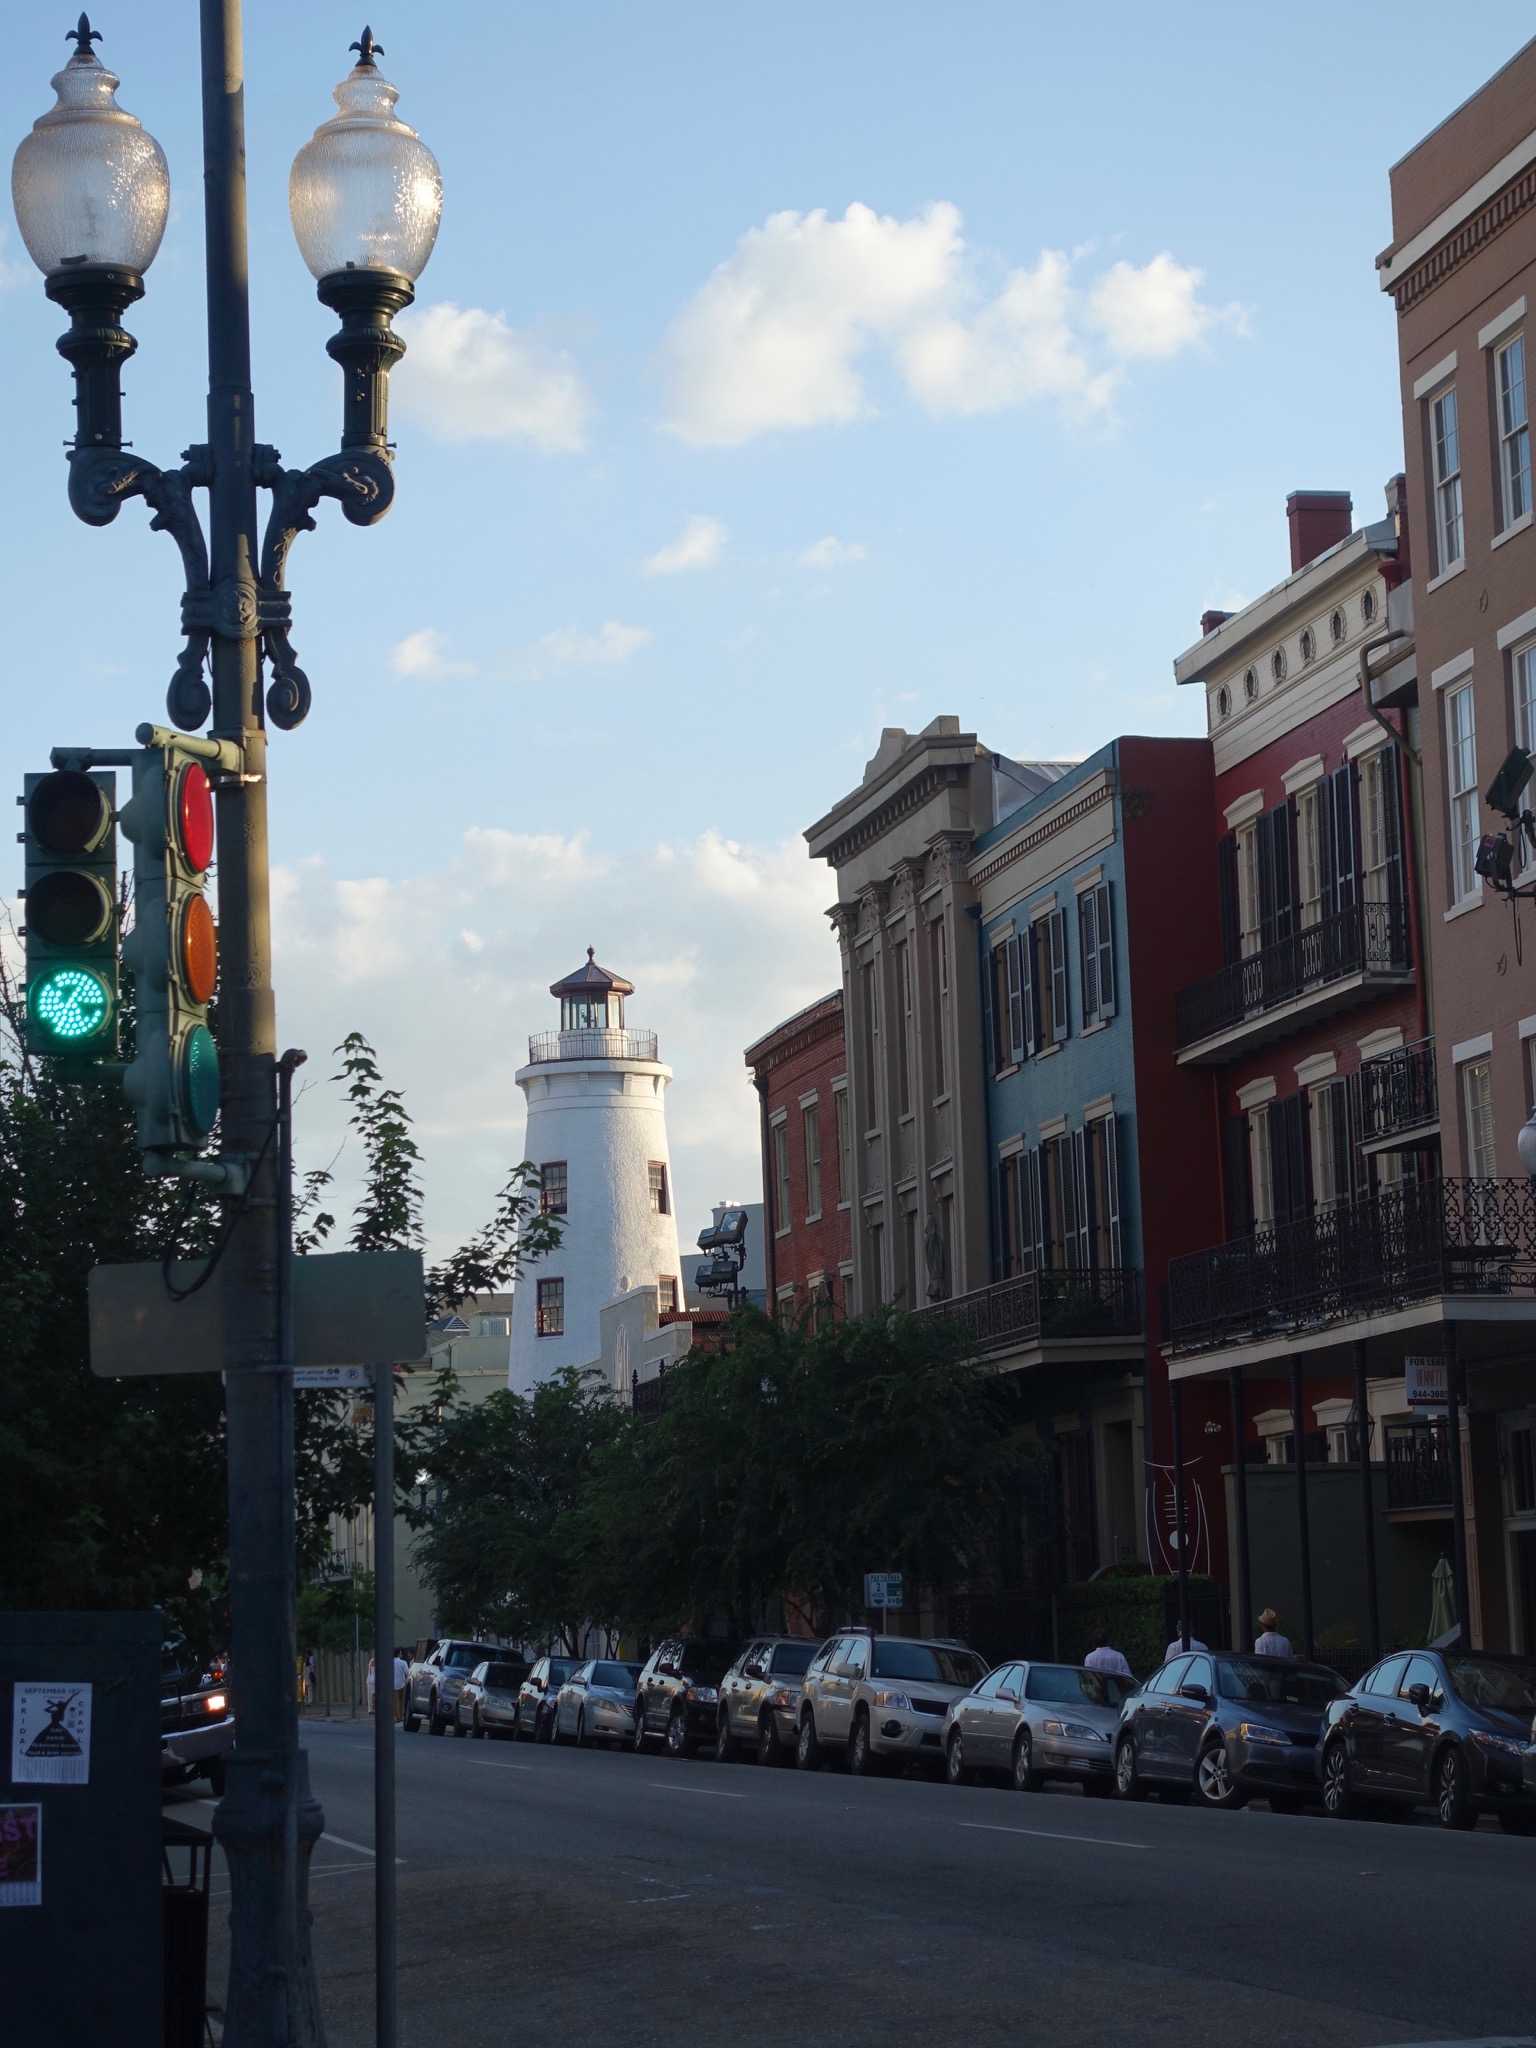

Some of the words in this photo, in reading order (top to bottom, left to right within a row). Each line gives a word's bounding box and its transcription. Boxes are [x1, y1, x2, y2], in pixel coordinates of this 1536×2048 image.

[1410, 1358, 1424, 1366] FOR
[1428, 1358, 1446, 1366] LEAS
[19, 1697, 27, 1755] BRIDAL
[76, 1701, 85, 1744] CRAWL
